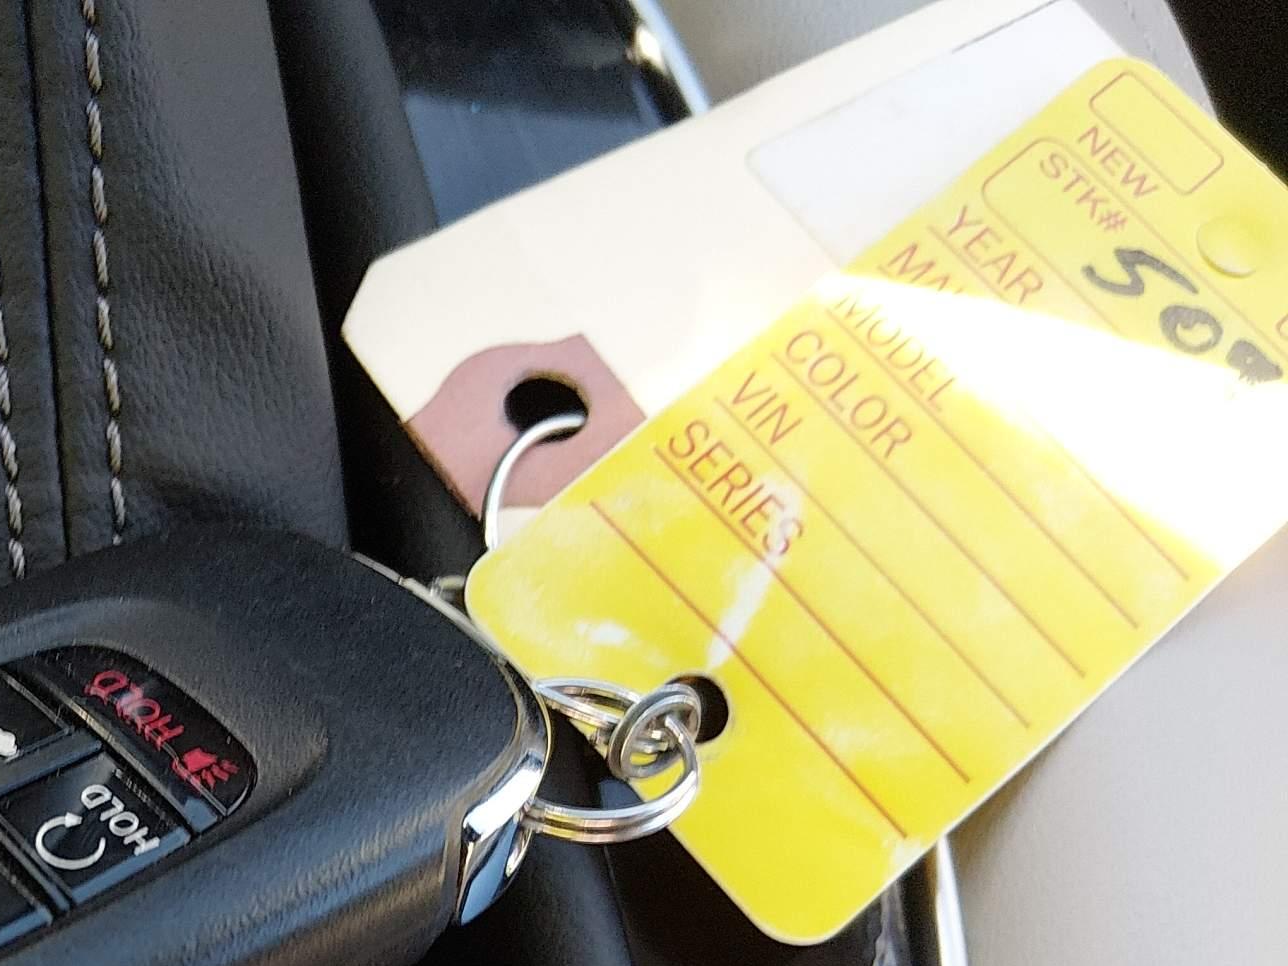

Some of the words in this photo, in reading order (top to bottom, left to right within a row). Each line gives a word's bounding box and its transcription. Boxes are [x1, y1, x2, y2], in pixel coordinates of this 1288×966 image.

[1039, 152, 1128, 233] STK#
[1078, 126, 1159, 199] NEW
[946, 205, 1045, 304] YEAR
[732, 370, 803, 446] VIN
[785, 329, 912, 459] COLOR
[668, 419, 804, 557] SERIES
[81, 784, 161, 856] HOLD
